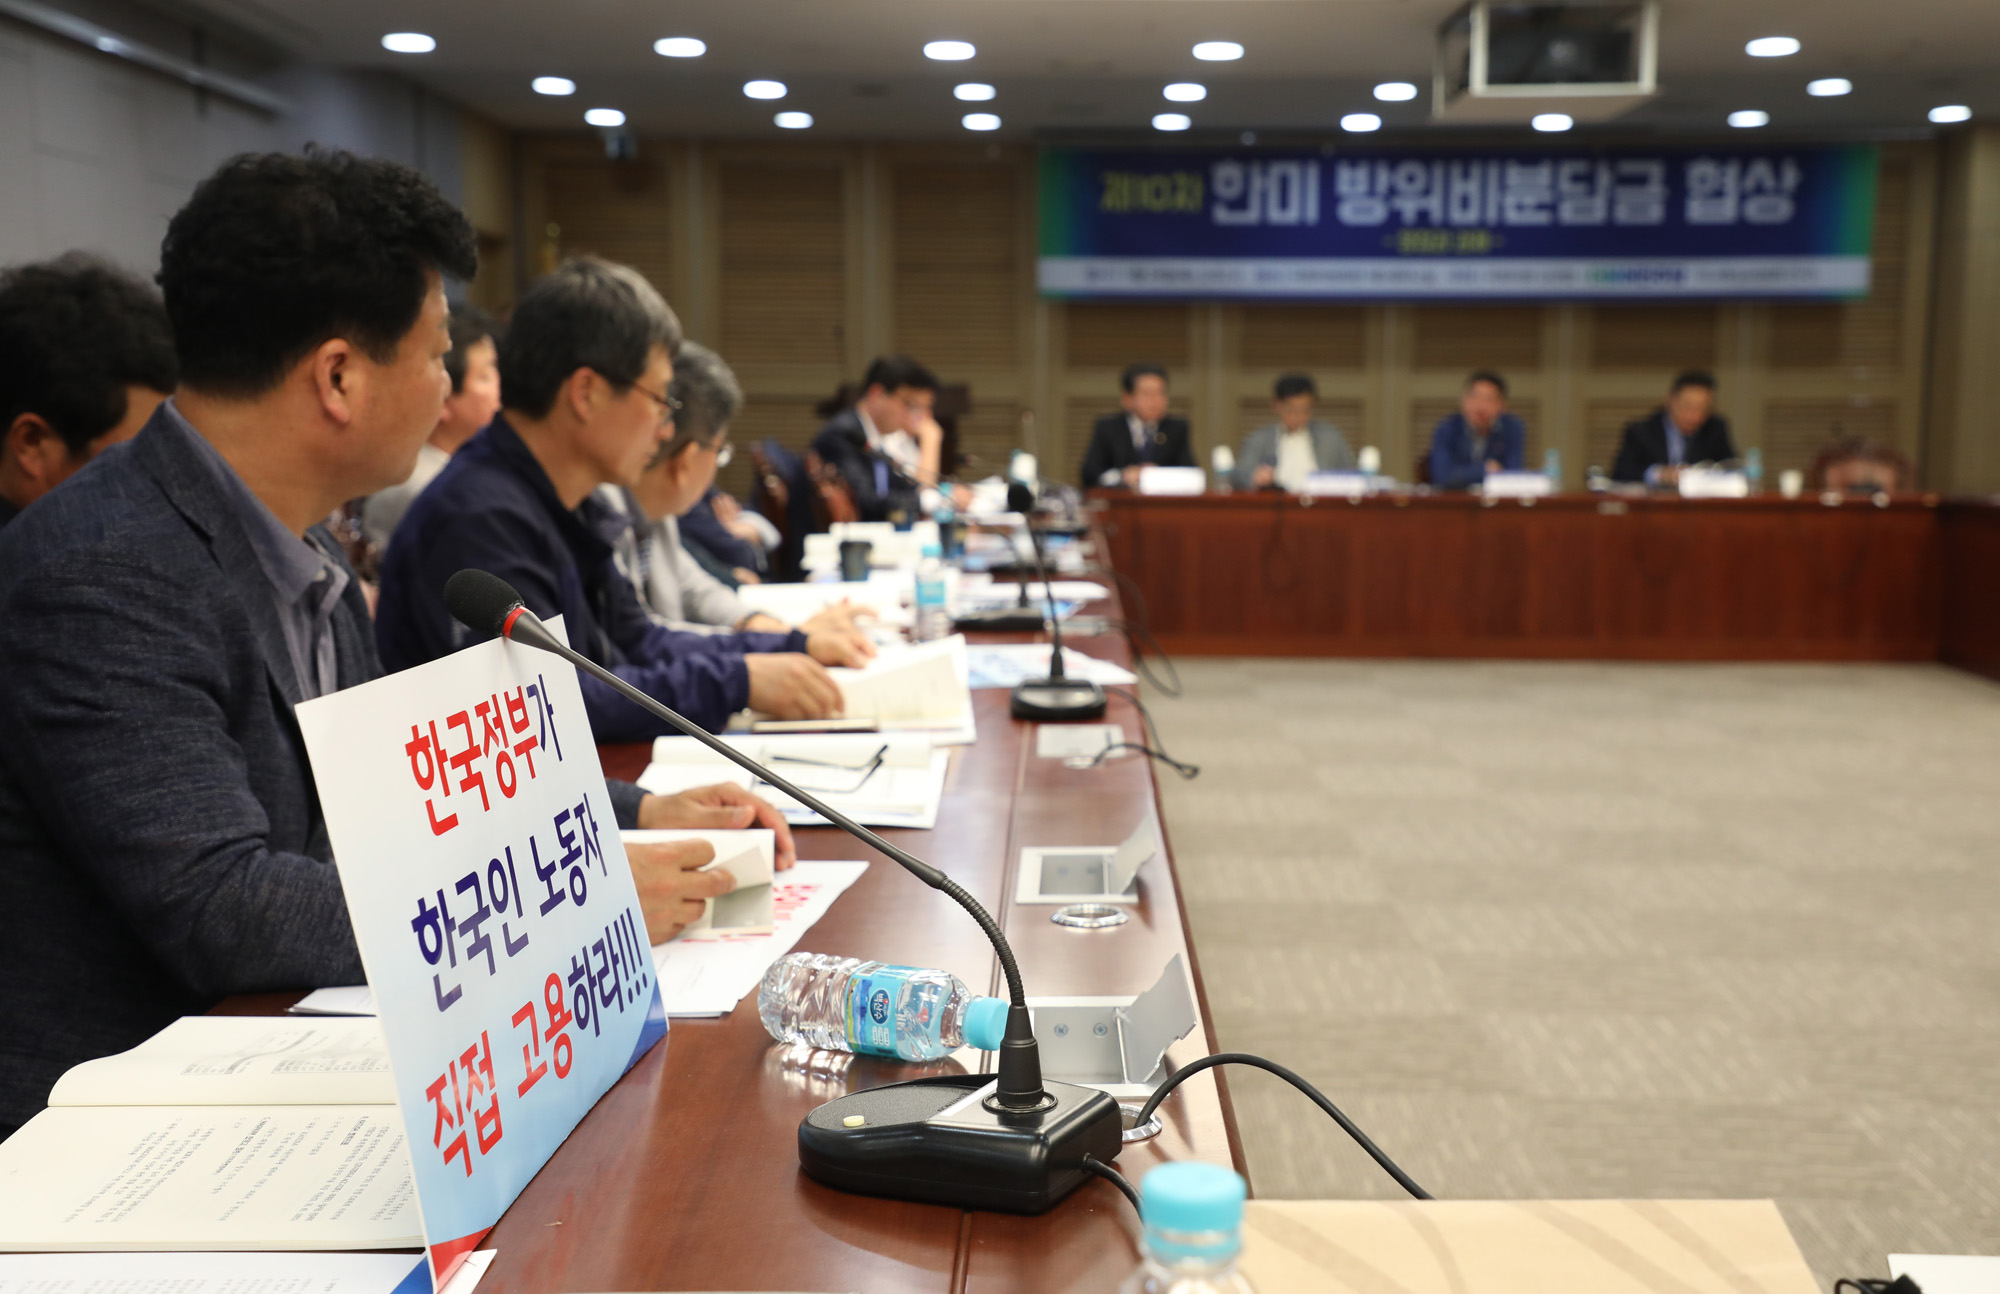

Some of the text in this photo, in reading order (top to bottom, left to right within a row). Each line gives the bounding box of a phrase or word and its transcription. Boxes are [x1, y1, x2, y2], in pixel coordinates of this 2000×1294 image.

[1211, 159, 1320, 226] 한미
[1335, 159, 1667, 227] 방위비분담금
[1684, 158, 1799, 226] 협상
[405, 674, 563, 836] 한국정부가
[411, 792, 607, 1012] 한국인 노동자
[425, 1030, 503, 1178] 직접
[511, 907, 648, 1099] 고용하라!!!
